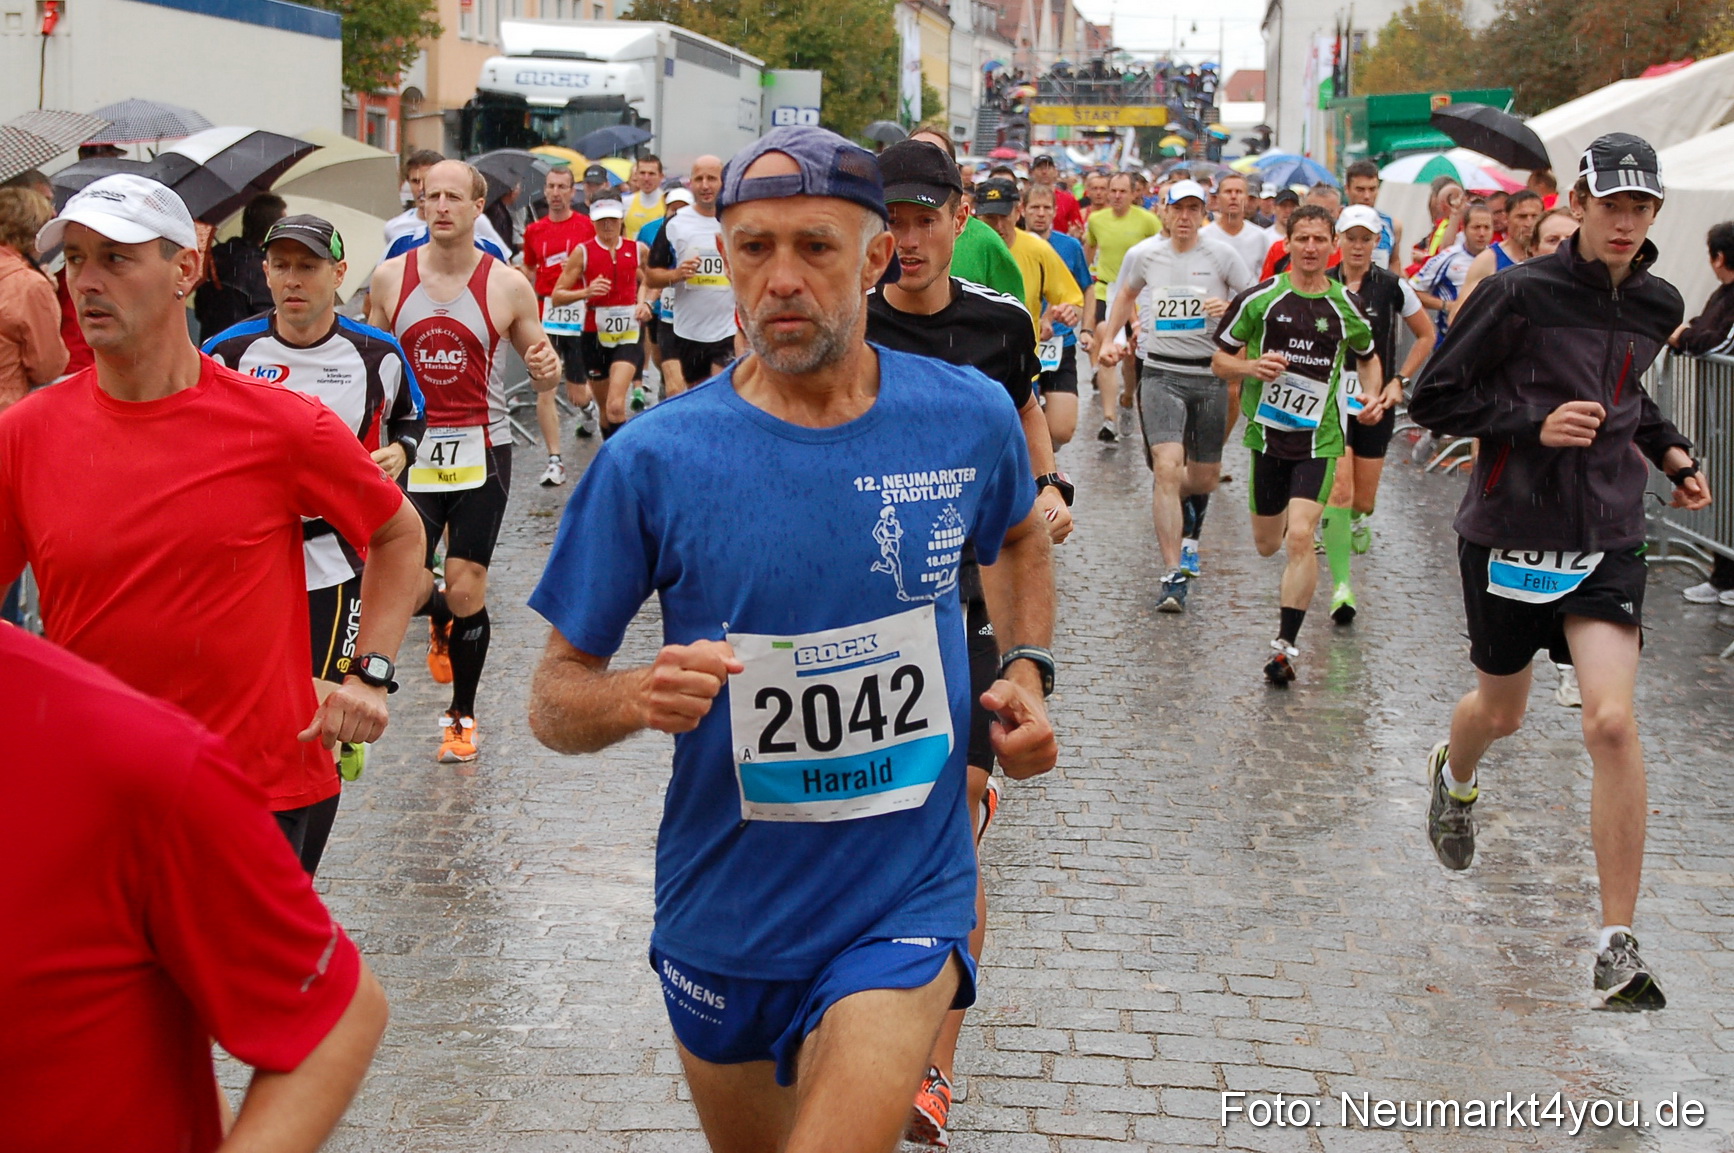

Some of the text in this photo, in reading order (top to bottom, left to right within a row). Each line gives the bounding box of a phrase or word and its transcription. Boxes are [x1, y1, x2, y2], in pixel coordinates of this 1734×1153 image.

[516, 71, 589, 88] BOCK
[1074, 110, 1120, 121] START
[695, 257, 723, 274] 209
[548, 307, 580, 322] 2135
[1158, 299, 1201, 318] 2212
[605, 317, 631, 333] 207
[1288, 337, 1314, 351] DAV
[419, 349, 463, 364] LAC
[249, 365, 278, 379] tkn
[1267, 383, 1320, 416] 3147
[430, 440, 460, 466] 47
[438, 472, 457, 482] Kurt
[853, 467, 976, 491] 12. NEUMARKTER
[880, 484, 962, 504] STADTLAUF
[1523, 573, 1559, 590] Felix
[341, 597, 361, 658] SKINS
[794, 633, 878, 666] BOCK
[743, 664, 928, 761] A 2042
[802, 757, 893, 794] Harald
[663, 959, 726, 1010] SIEMENS
